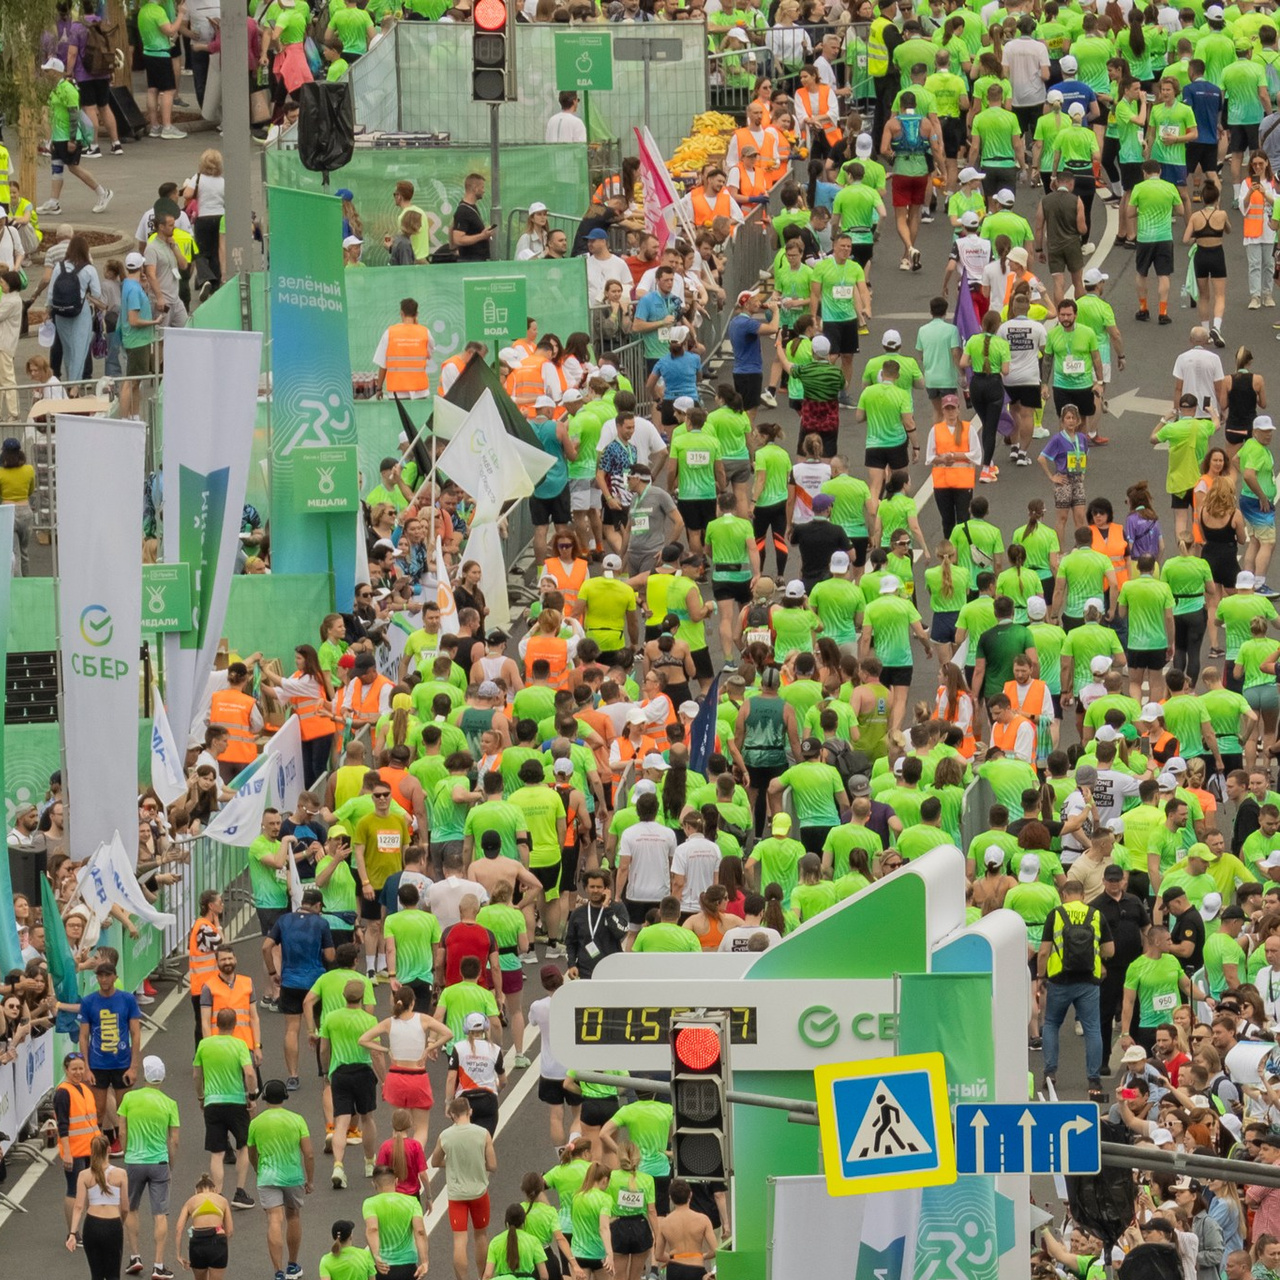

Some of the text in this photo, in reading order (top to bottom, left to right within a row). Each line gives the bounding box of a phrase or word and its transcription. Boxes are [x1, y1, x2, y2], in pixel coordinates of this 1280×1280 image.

[577, 78, 593, 86] ЕДА
[278, 274, 341, 298] зелёный
[278, 290, 343, 313] марафон
[484, 326, 509, 336] ВОДА
[307, 497, 348, 508] МЕДАЛИ
[71, 652, 130, 681] СБЕР
